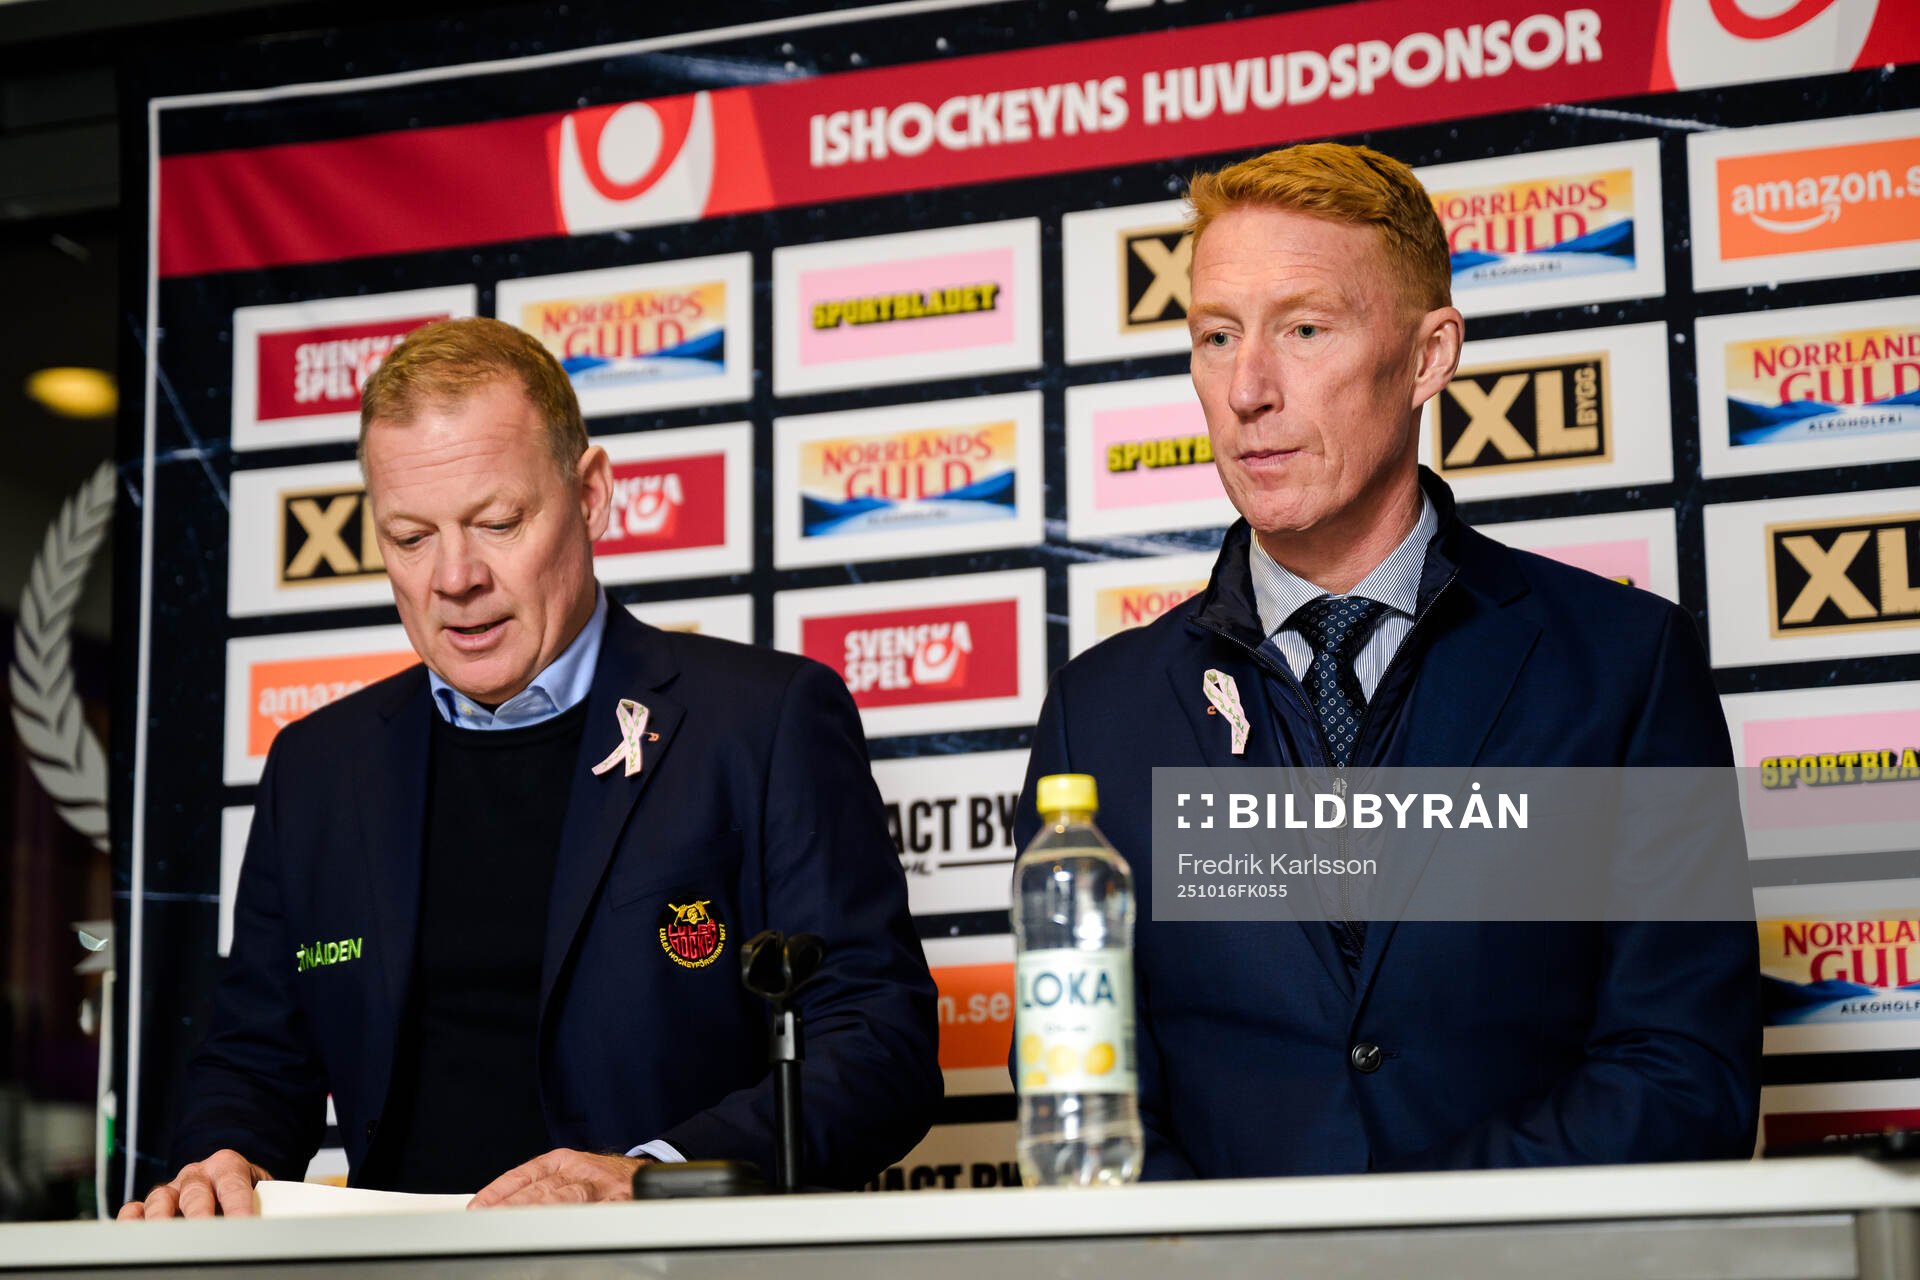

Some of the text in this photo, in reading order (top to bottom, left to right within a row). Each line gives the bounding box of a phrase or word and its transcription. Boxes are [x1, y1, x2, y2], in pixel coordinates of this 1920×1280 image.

[810, 9, 1602, 167] ISHOCKEYNS HUVUDSPONSOR
[1731, 164, 1920, 215] amazon.s
[1450, 211, 1587, 254] GULD
[1129, 233, 1193, 320] X
[543, 290, 704, 335] NORRLANDS
[812, 282, 998, 330] SPORTBLADET
[564, 319, 686, 360] GULD
[1753, 334, 1920, 379] NORRLAND
[294, 364, 356, 403] SPEL
[1574, 366, 1598, 426] BYGG
[1444, 369, 1598, 466] XL
[822, 430, 993, 476] NORRLANDS
[1108, 435, 1215, 473] SPORTB
[844, 460, 973, 502] GULD
[844, 621, 974, 662] SVENSKA
[844, 656, 912, 693] SPEL
[1761, 747, 1920, 789] SPORTBLA
[969, 793, 1020, 850] BY
[1784, 920, 1920, 956] NORRLA
[1810, 947, 1920, 988] GUL
[1020, 971, 1117, 1009] LOKA
[1841, 1001, 1920, 1015] ALKOHOLF
